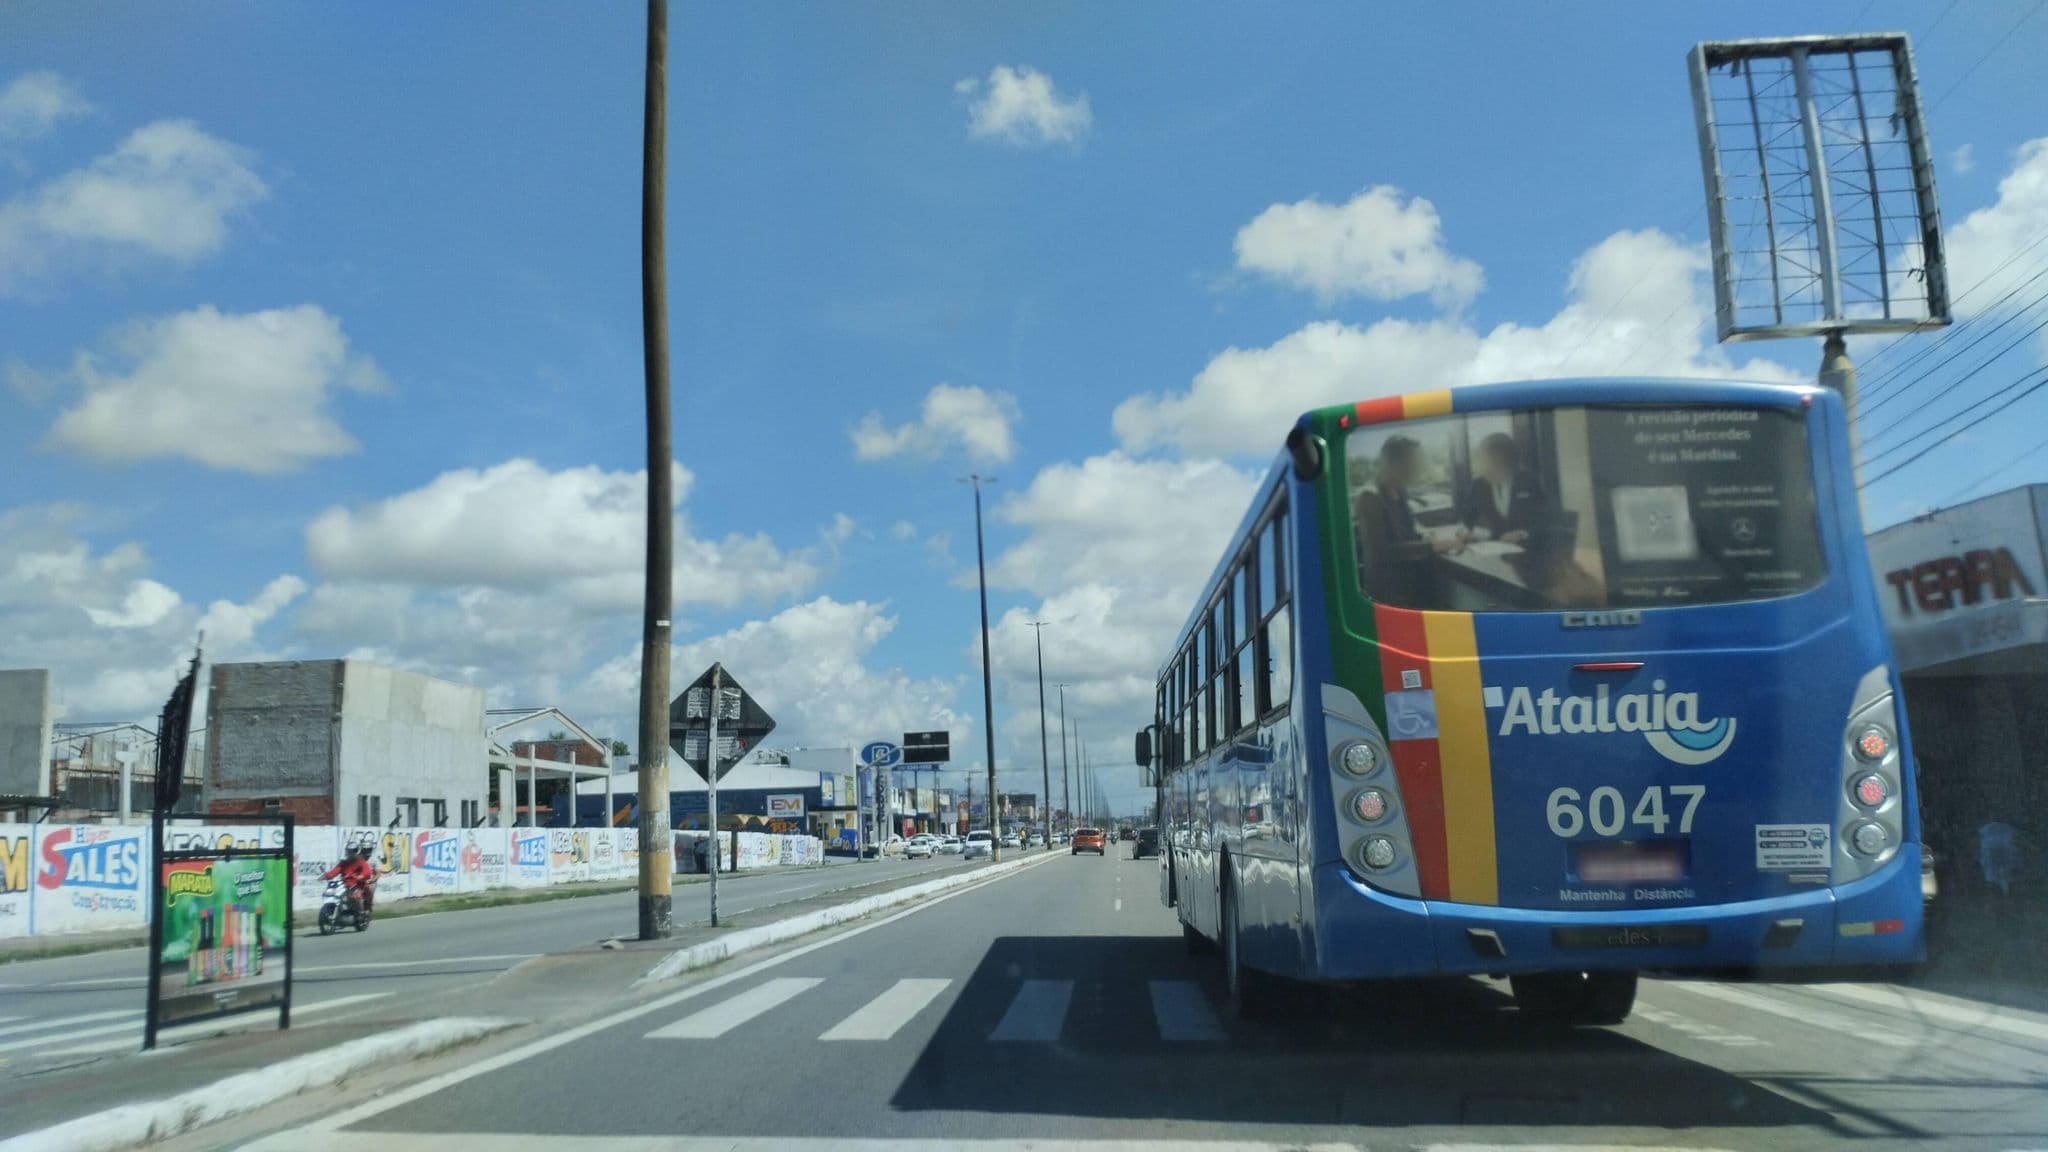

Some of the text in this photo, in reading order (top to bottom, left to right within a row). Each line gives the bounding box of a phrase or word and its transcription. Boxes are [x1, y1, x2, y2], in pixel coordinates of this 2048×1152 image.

[1885, 547, 2036, 619] TERRA
[1498, 679, 1719, 736] Atalaia
[1546, 784, 1706, 837] 6047
[37, 827, 139, 890] SALES
[1560, 887, 1696, 901] Mantenha Distância
